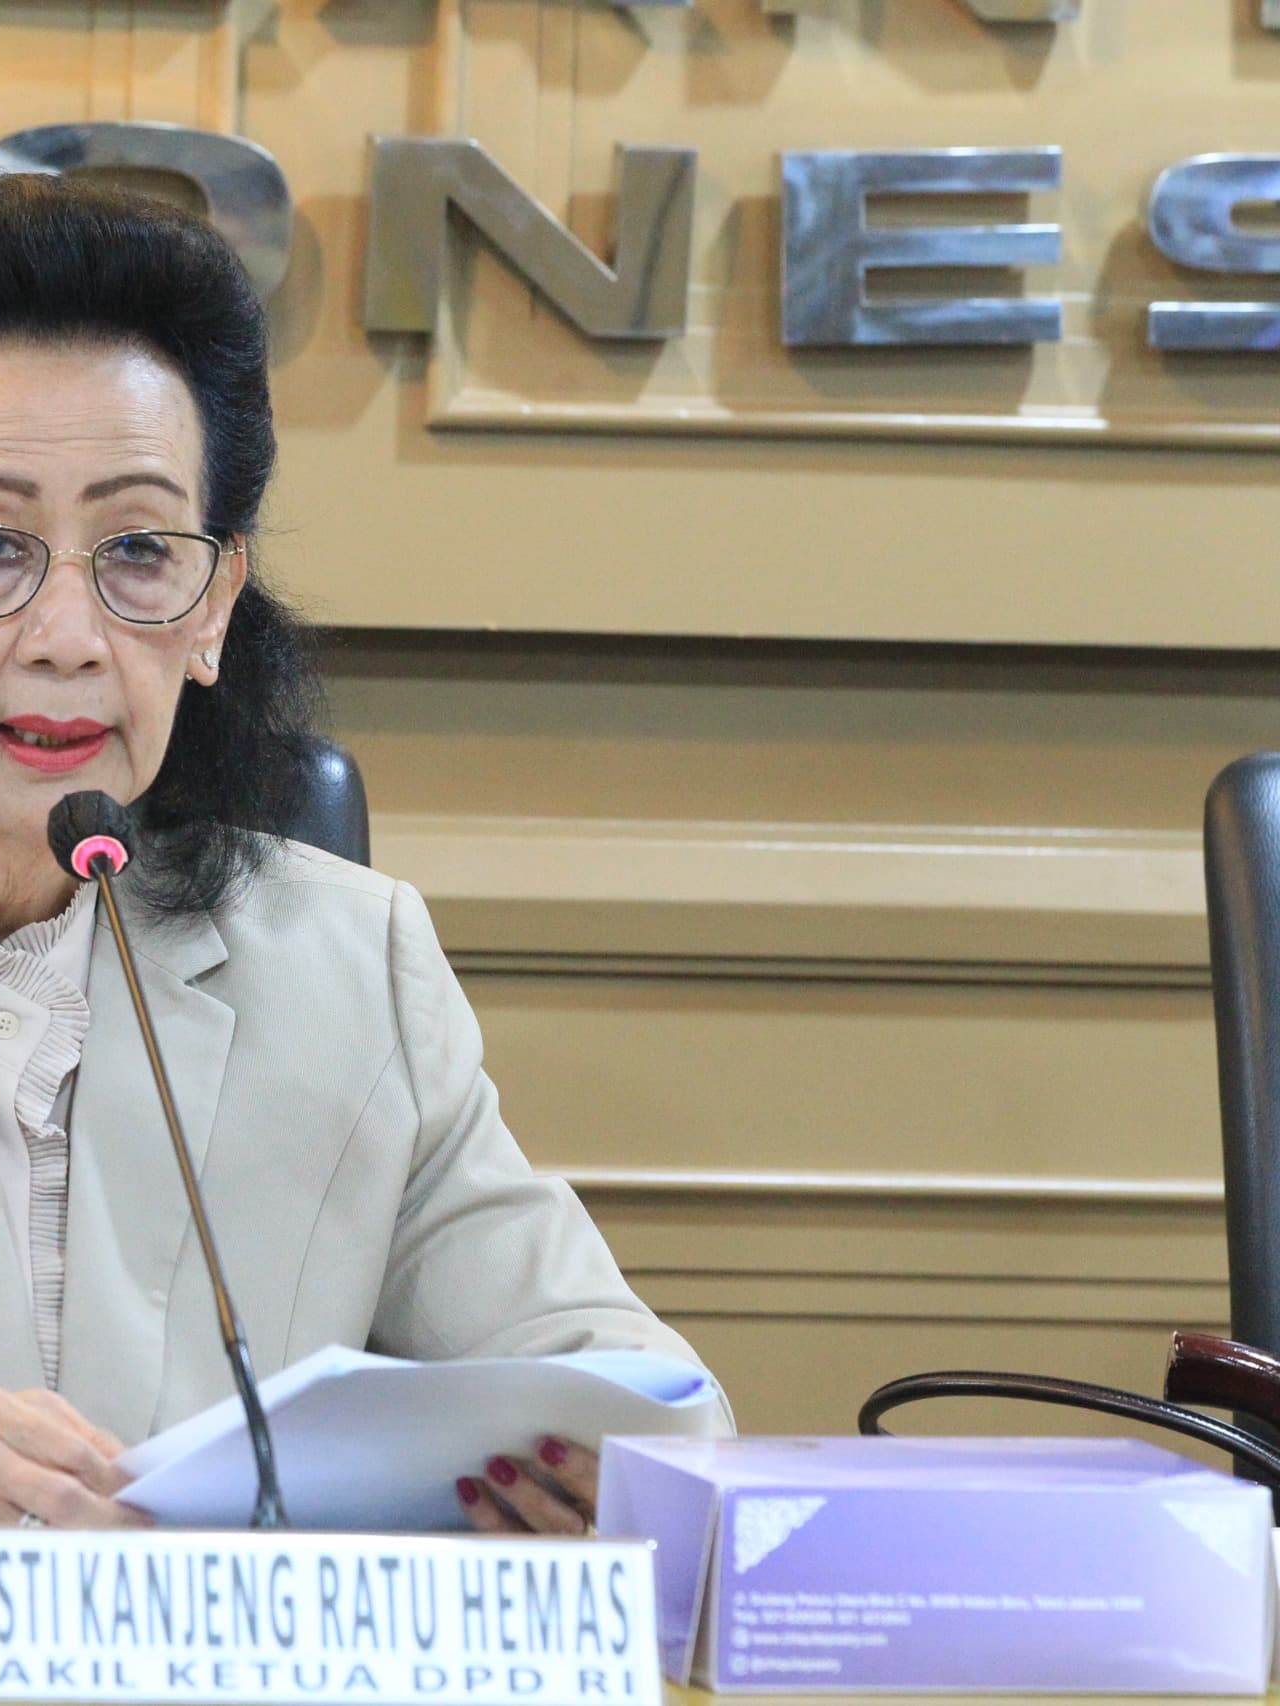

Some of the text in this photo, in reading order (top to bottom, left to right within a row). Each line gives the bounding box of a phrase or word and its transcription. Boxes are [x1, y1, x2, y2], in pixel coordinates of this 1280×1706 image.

[79, 1551, 296, 1648] KANJENG
[319, 1556, 437, 1651] RATU
[460, 1559, 629, 1656] HEMAS
[168, 1660, 378, 1691] KETUA
[414, 1665, 544, 1693] DPD
[579, 1669, 634, 1696] RI
